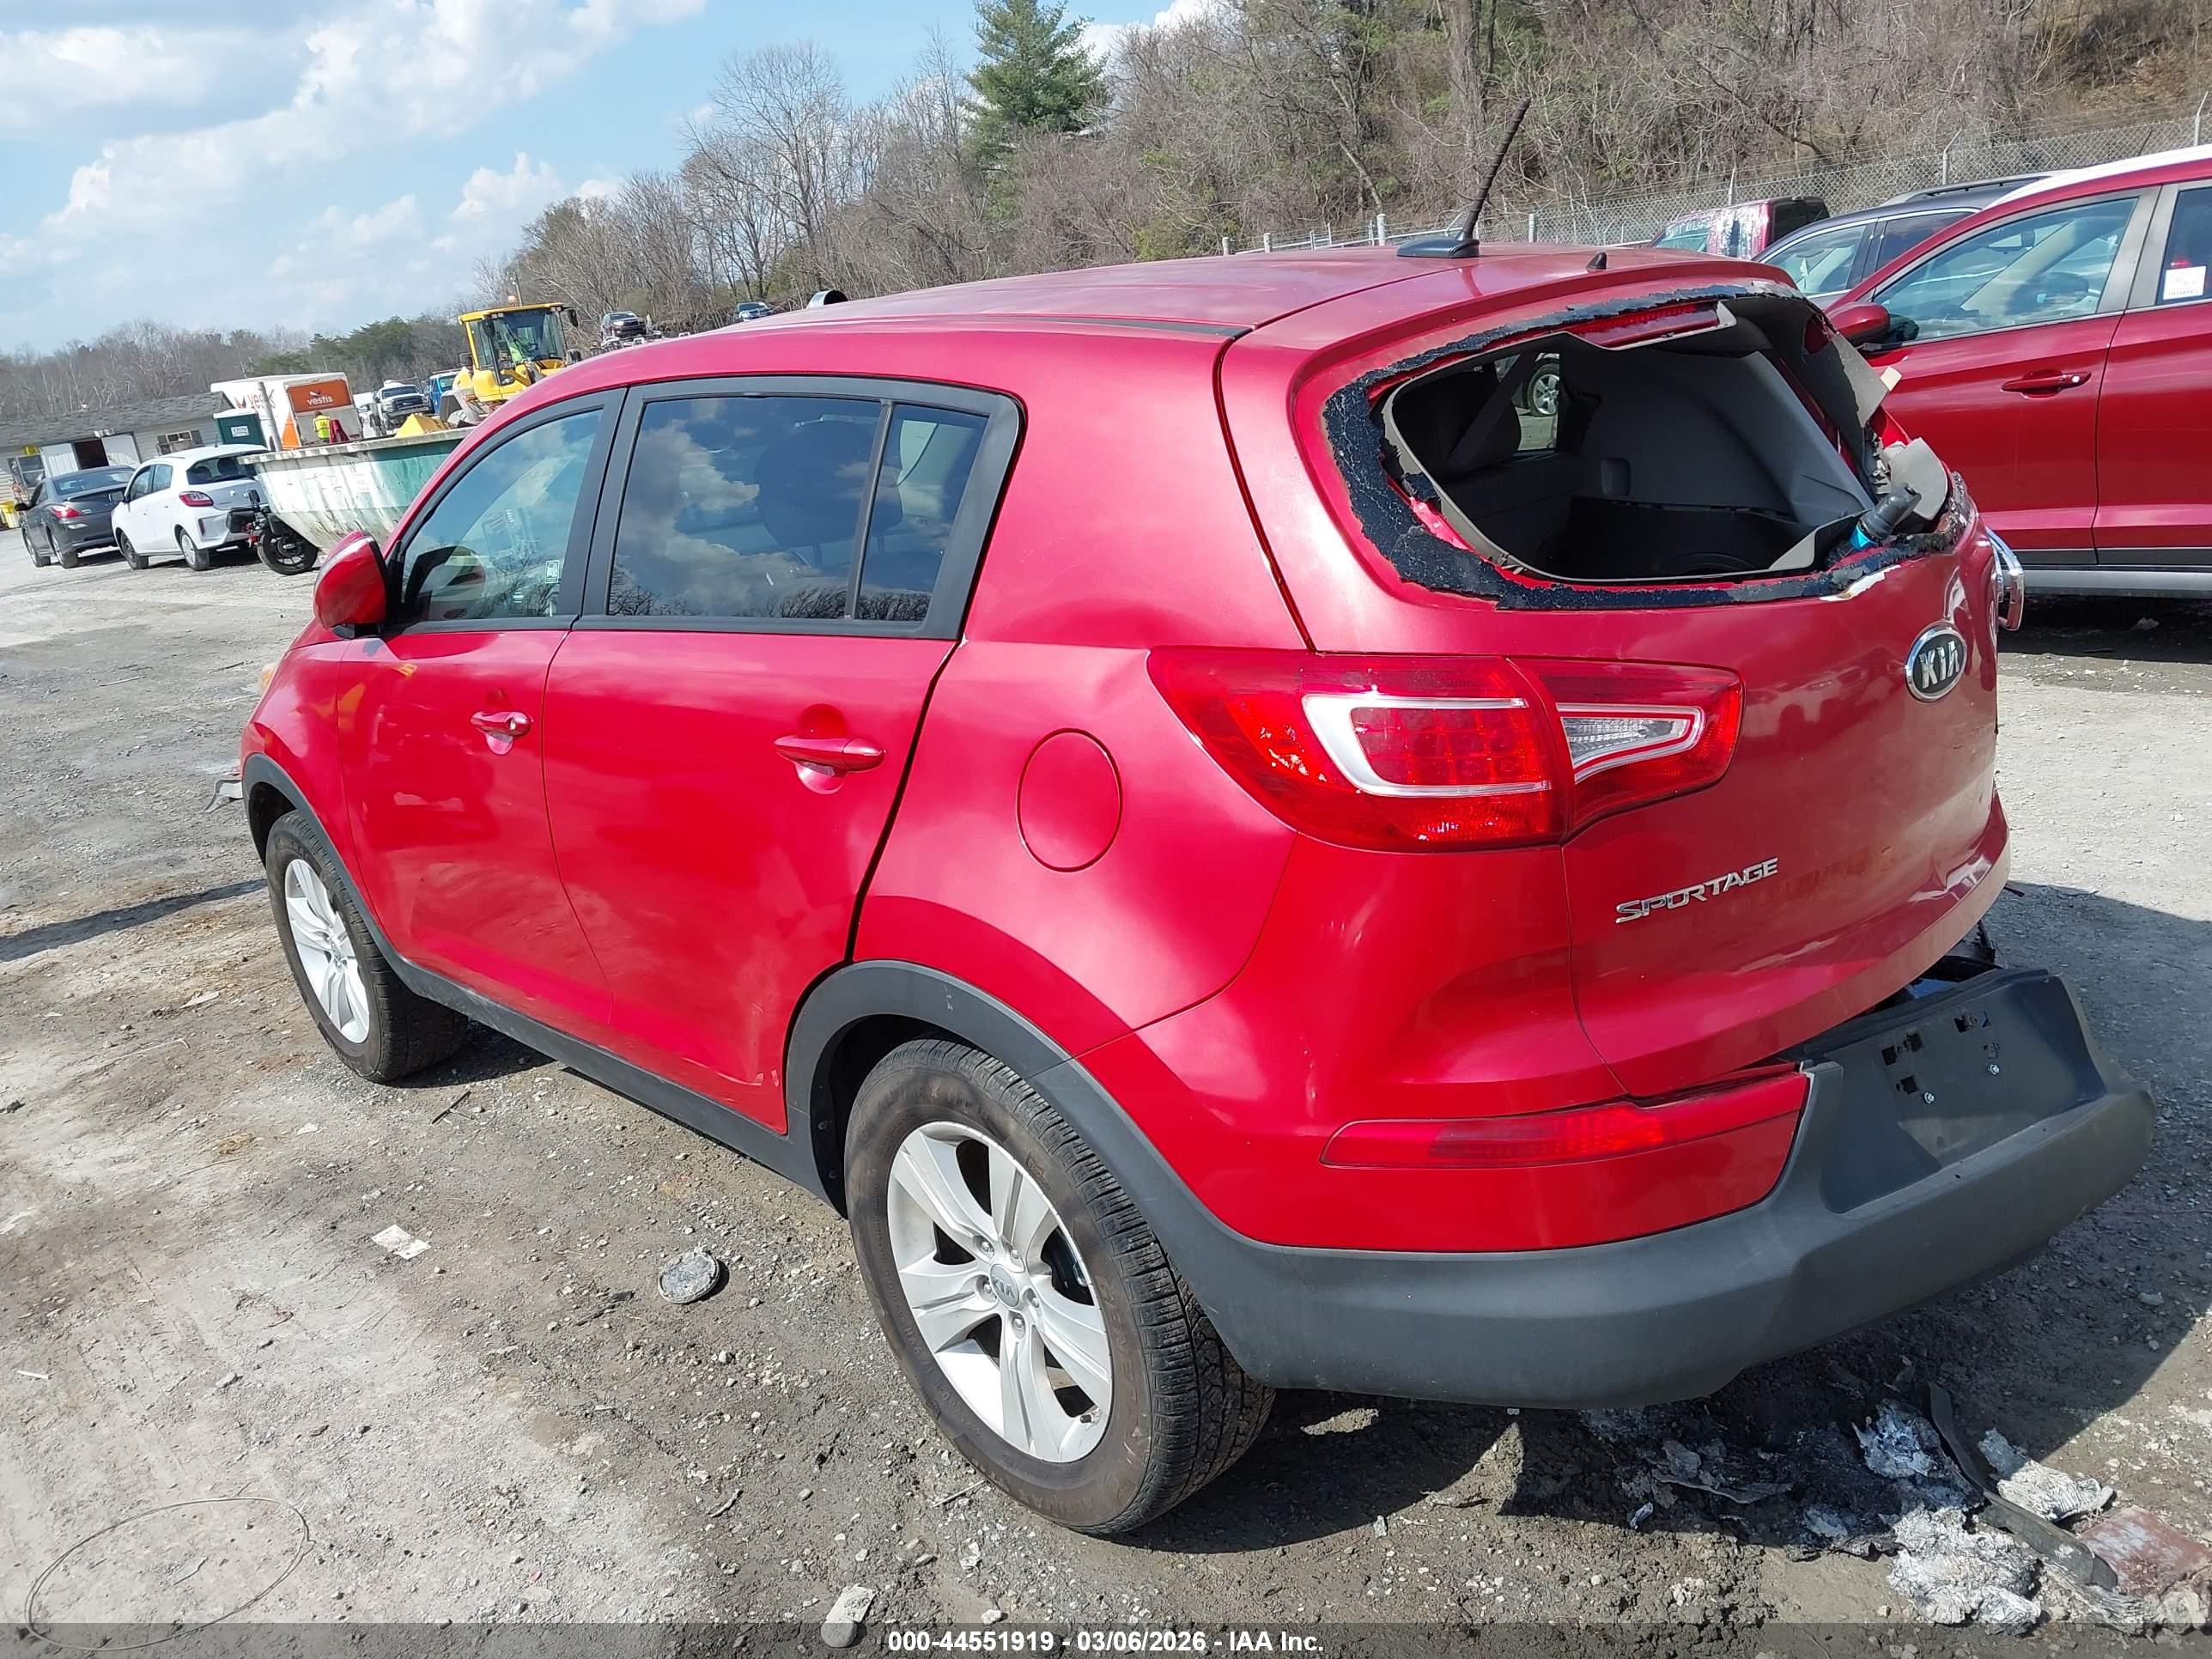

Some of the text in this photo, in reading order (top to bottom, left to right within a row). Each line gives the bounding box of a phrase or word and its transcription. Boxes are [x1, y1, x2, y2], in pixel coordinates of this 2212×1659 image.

[307, 394, 333, 405] vestis
[1918, 640, 1960, 689] KIA
[1615, 857, 1779, 925] SPORTAGE
[992, 1274, 1016, 1299] KIA
